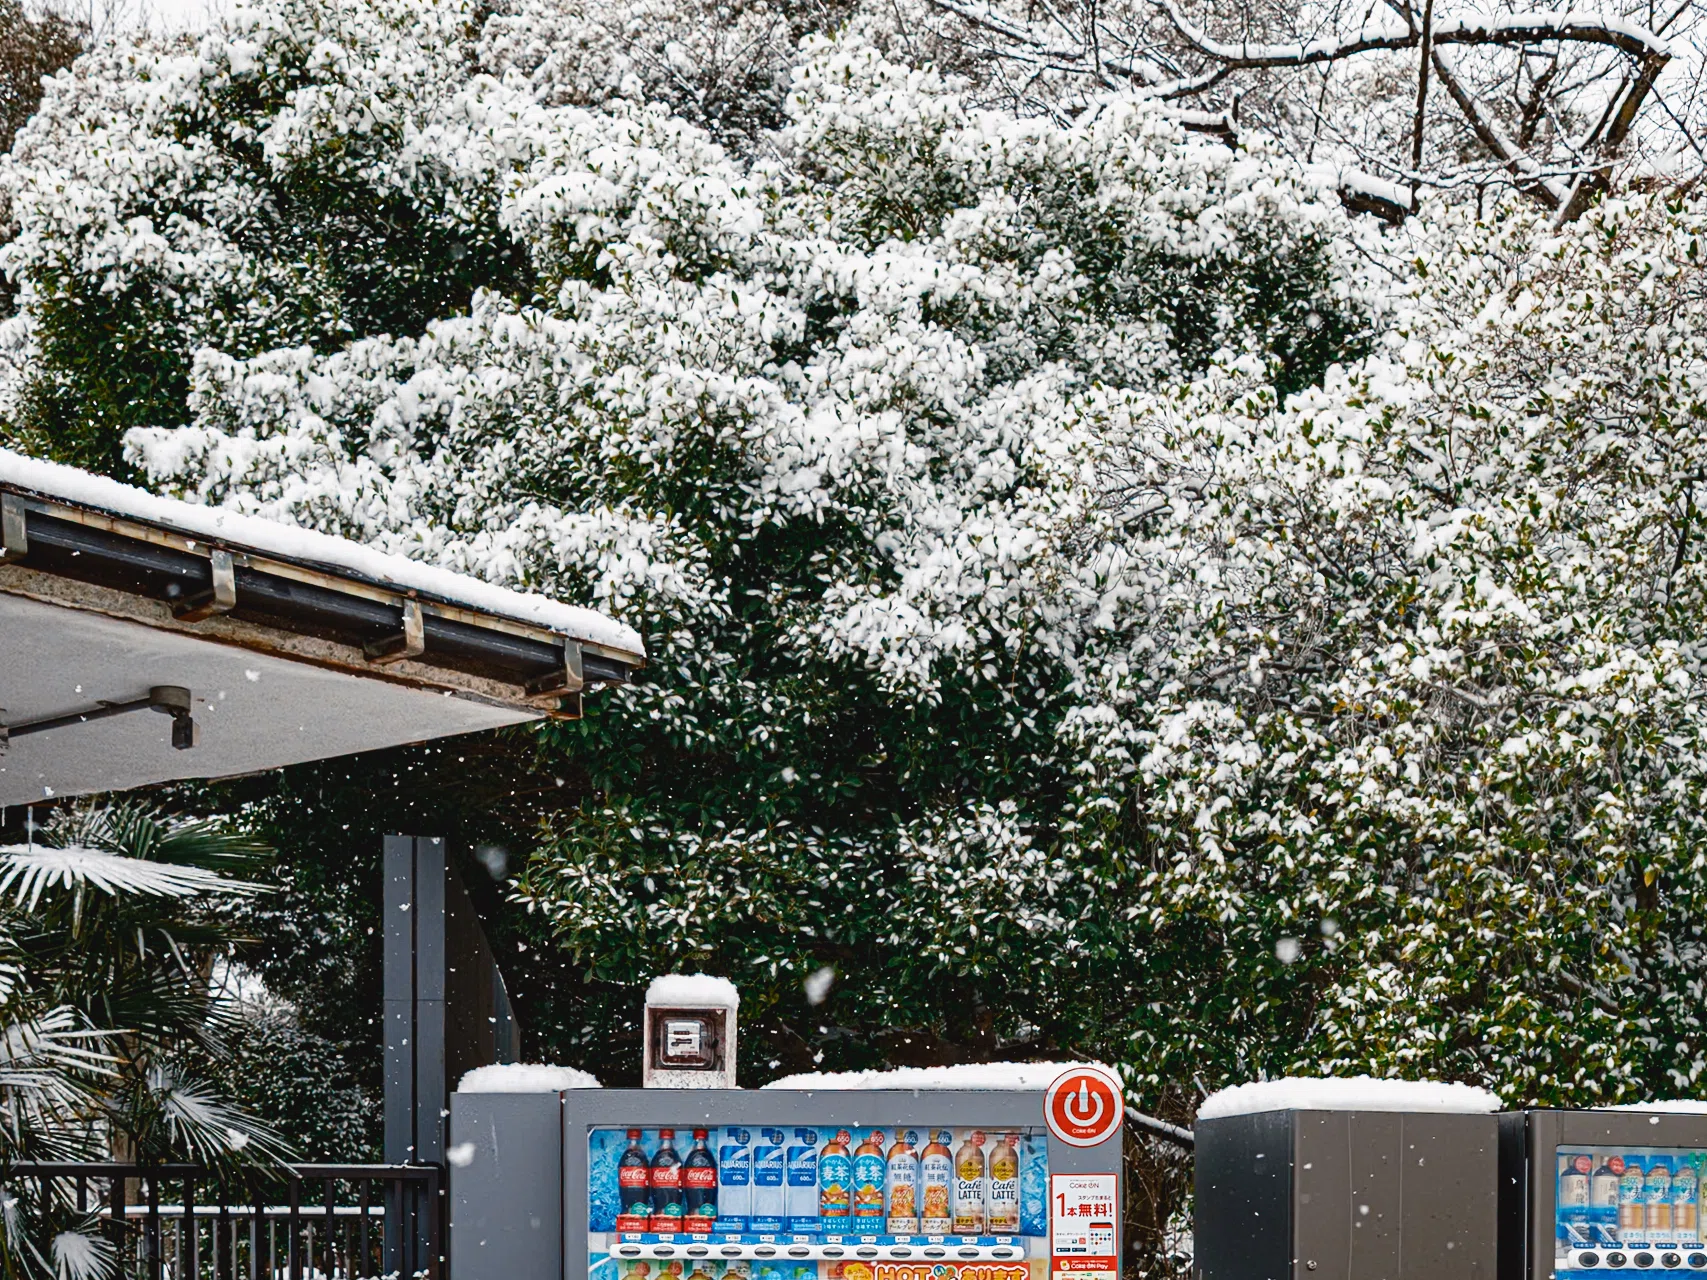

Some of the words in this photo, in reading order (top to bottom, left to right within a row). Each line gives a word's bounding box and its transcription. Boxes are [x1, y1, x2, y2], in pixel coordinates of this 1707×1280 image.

[720, 1160, 749, 1169] AQUARIUS
[754, 1160, 783, 1170] AQUARIUS
[787, 1161, 816, 1170] AQUARIUS
[620, 1168, 647, 1180] Coca-Cola
[687, 1169, 713, 1181] Coca-Cola
[822, 1165, 849, 1181] 麦茶
[856, 1165, 883, 1181] 麦茶
[958, 1180, 982, 1190] Café
[992, 1180, 1015, 1190] Café
[958, 1190, 982, 1200] LATTE
[992, 1190, 1015, 1200] LATTE
[1096, 1263, 1109, 1271] Pay
